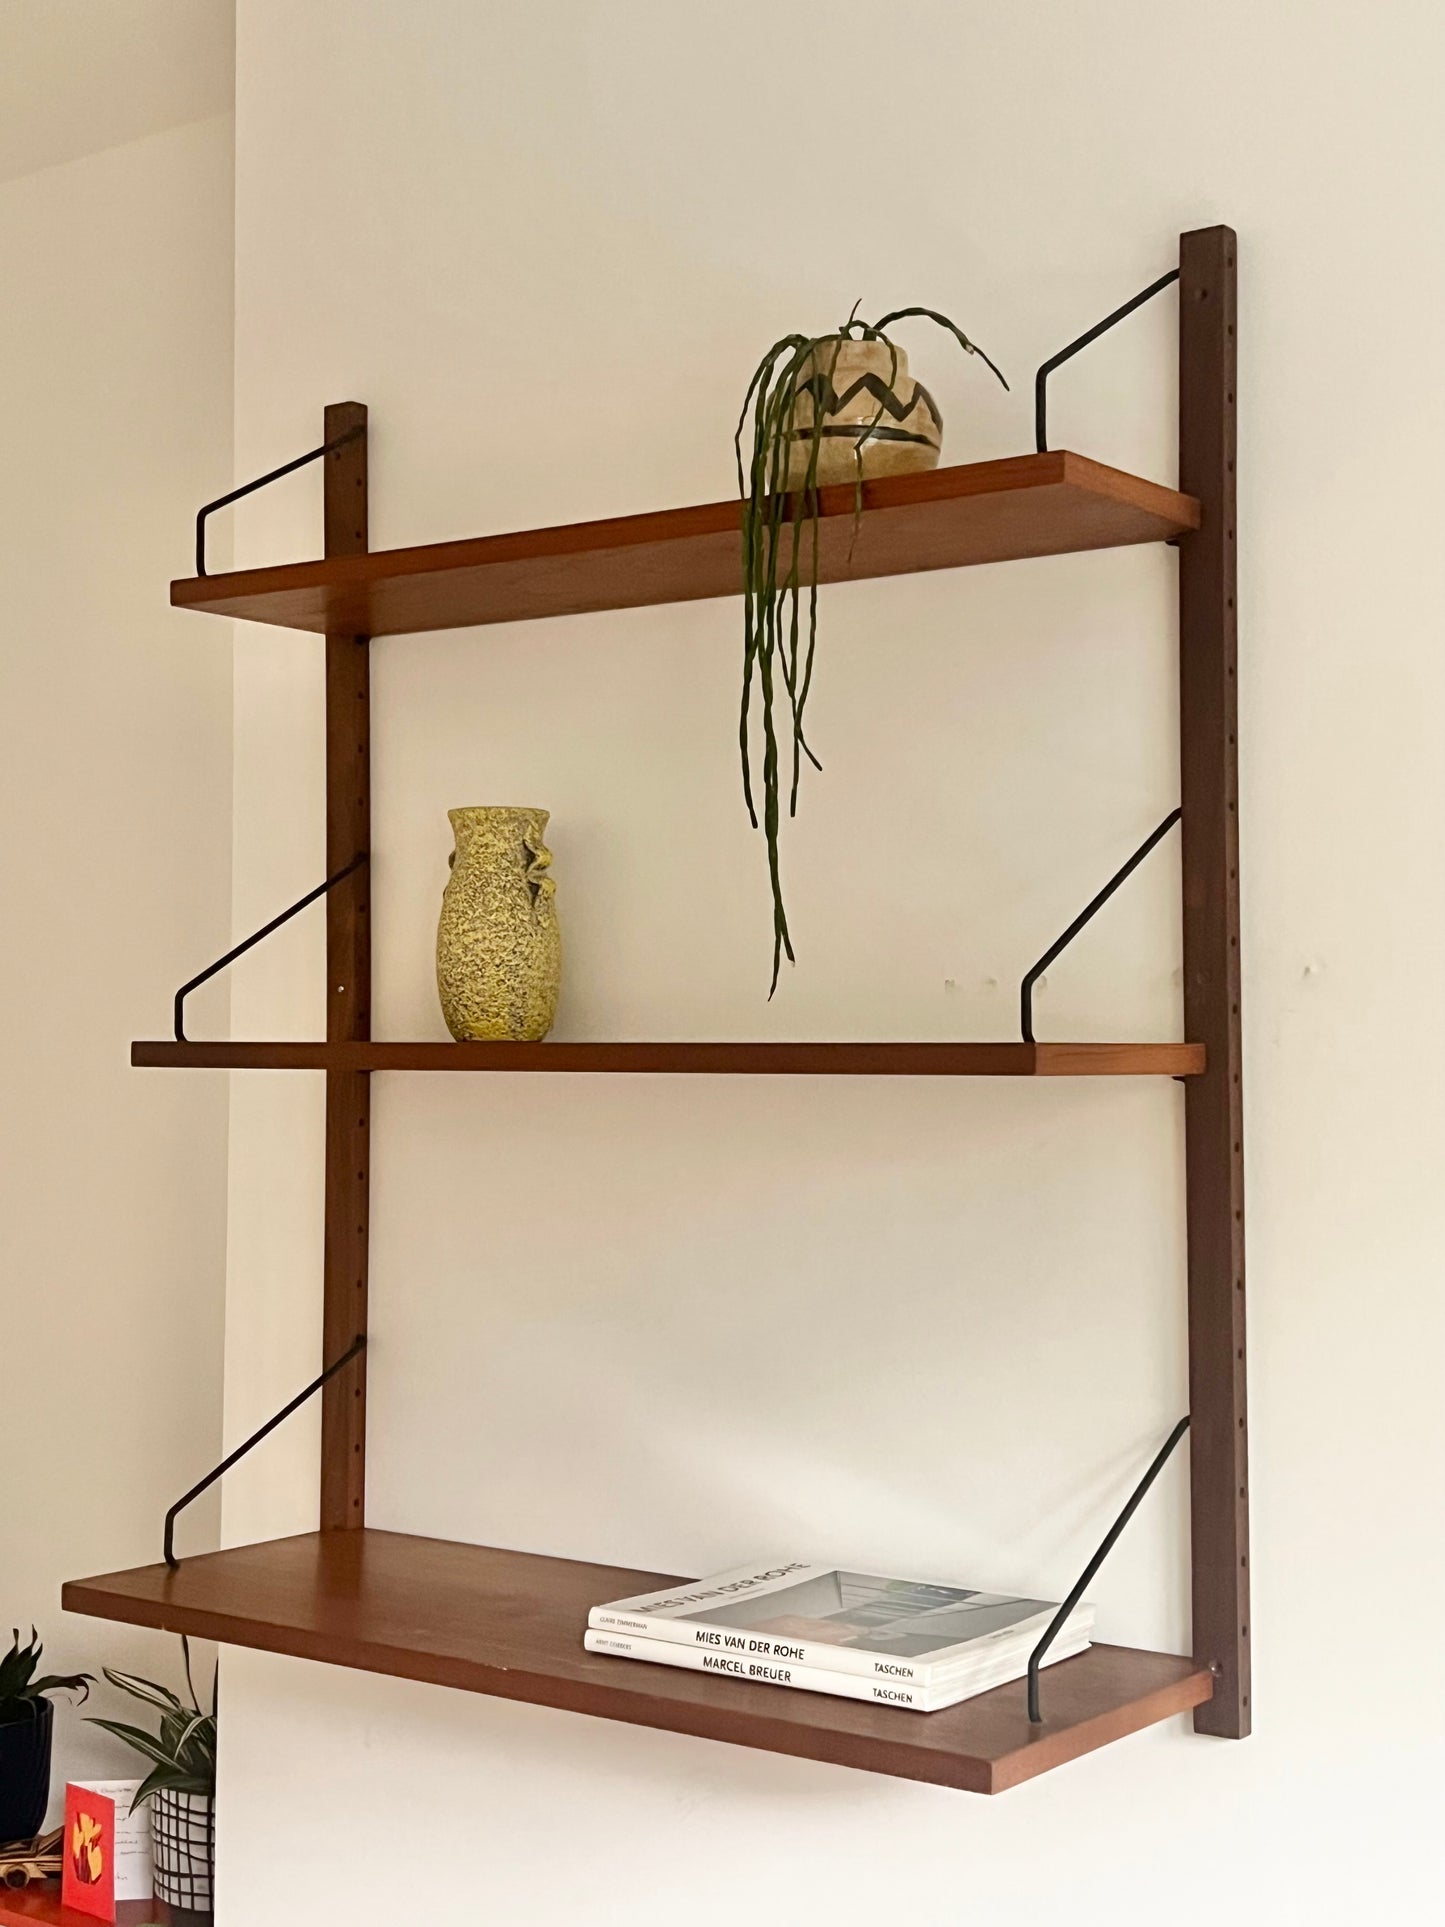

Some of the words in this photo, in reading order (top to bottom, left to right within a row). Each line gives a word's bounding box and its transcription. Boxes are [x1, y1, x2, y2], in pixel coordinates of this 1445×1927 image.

[629, 1600, 685, 1613] MIES
[673, 1590, 724, 1602] VAN
[717, 1581, 763, 1593] DER
[753, 1563, 811, 1581] ROHE
[695, 1630, 721, 1645] MIES
[724, 1635, 746, 1650] VAN
[749, 1639, 770, 1654] DER
[773, 1644, 806, 1660] ROHE
[703, 1655, 746, 1675] MARCEL
[749, 1664, 792, 1682] BREUER
[874, 1662, 914, 1678] TASCHEN
[872, 1687, 913, 1703] TASCHEN
